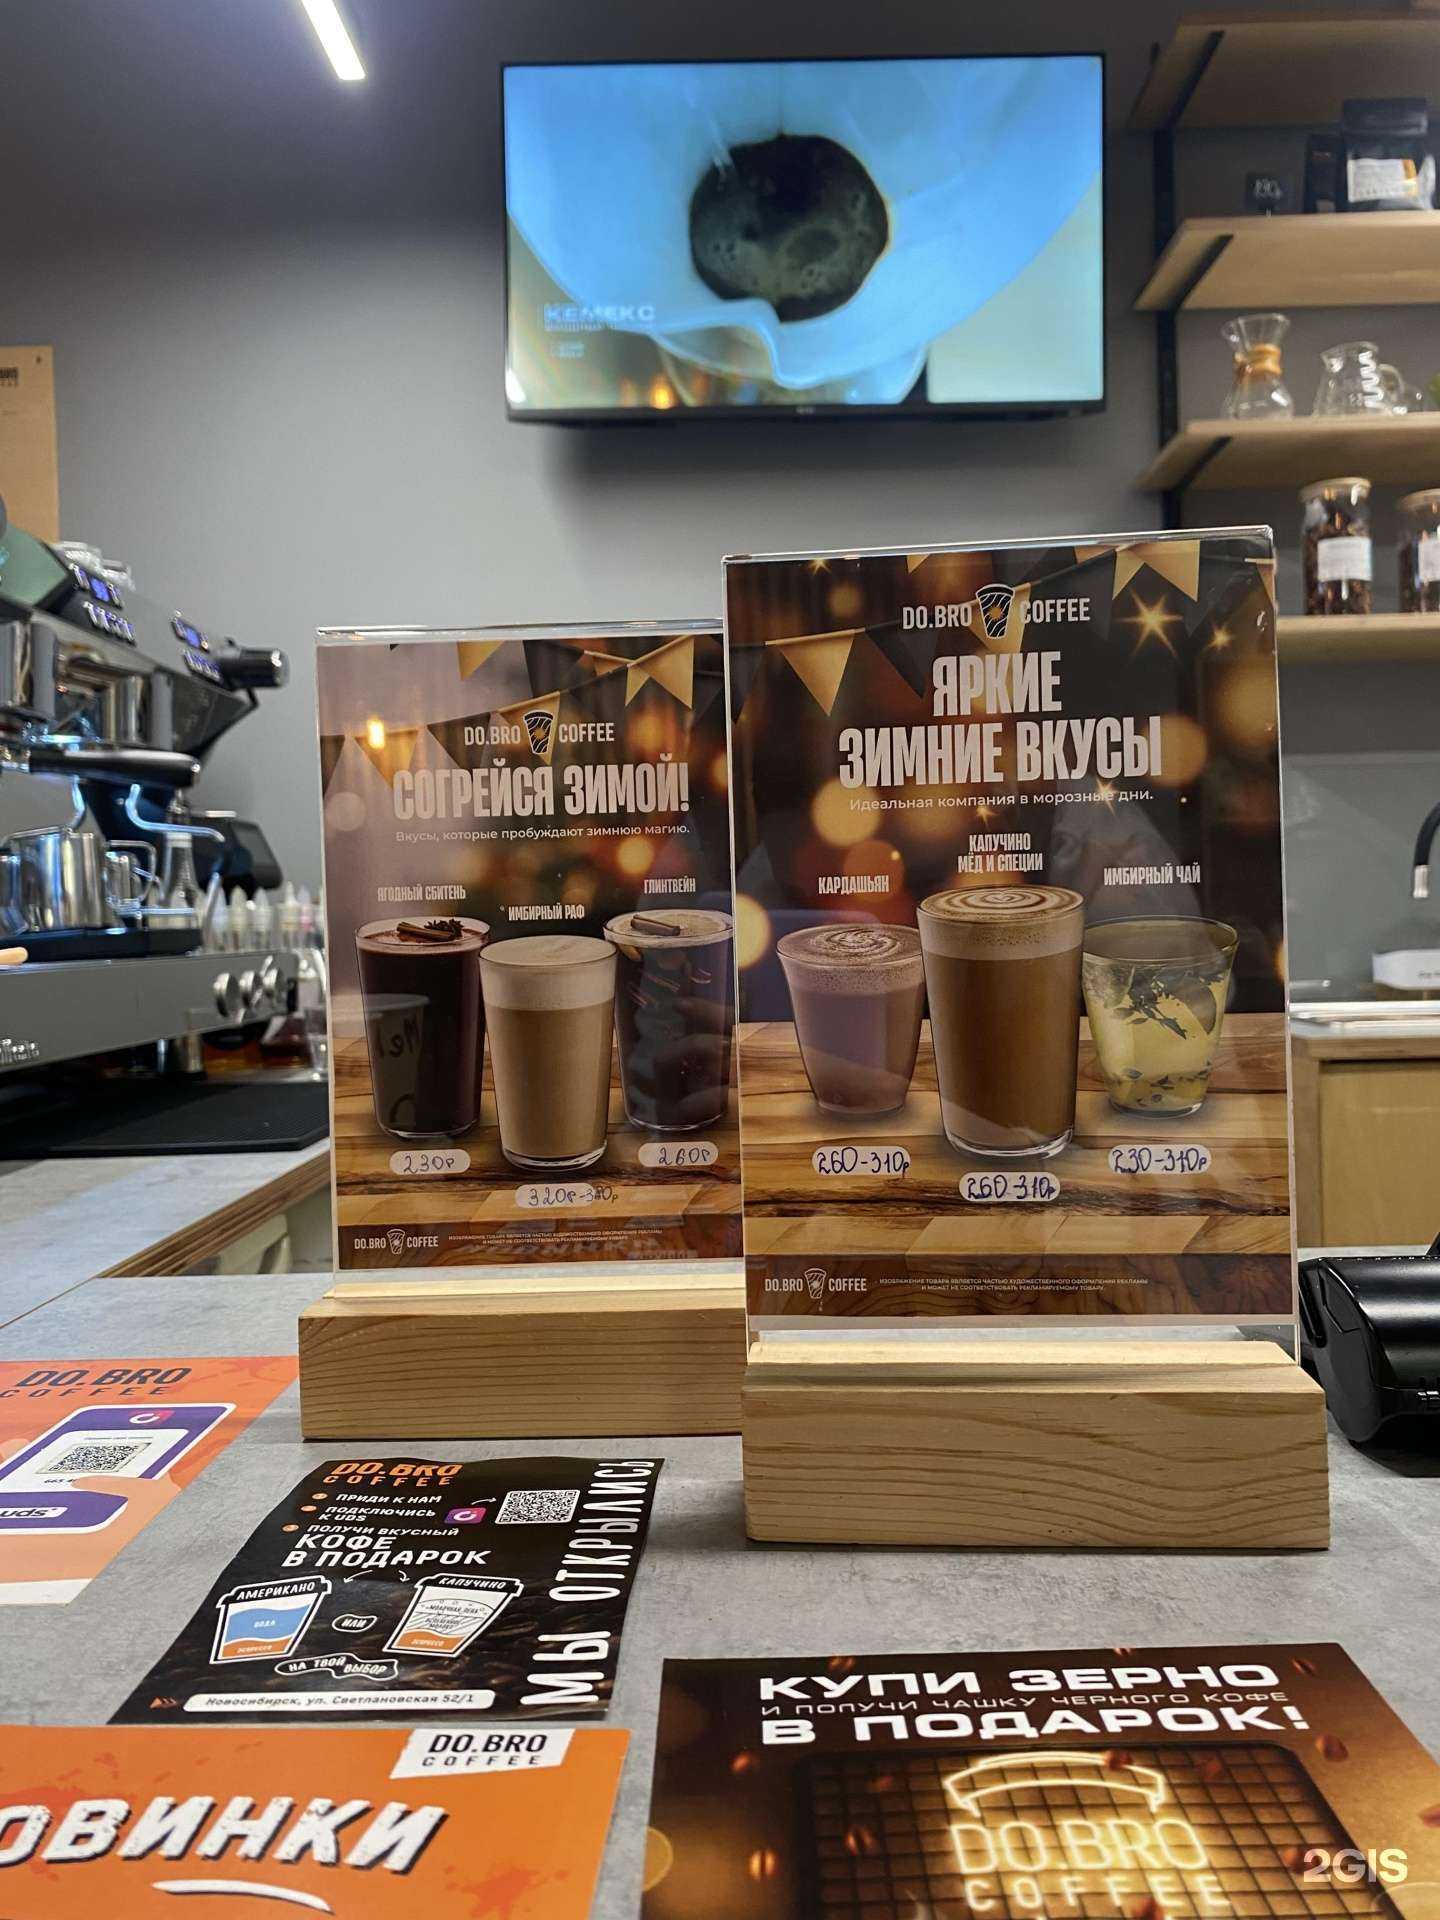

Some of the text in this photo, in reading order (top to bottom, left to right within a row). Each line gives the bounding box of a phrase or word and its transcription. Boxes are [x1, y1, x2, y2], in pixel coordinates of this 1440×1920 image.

[902, 598, 1091, 630] DO.BRO COFFEE
[932, 651, 1062, 717] ЯРКИЕ
[464, 723, 615, 746] DO.BRO COFFEE
[839, 716, 1162, 788] ЗИМНИЕ ВКУСЫ
[393, 753, 690, 820] СОГРЕЙСЯ ЗИМОЙ!
[850, 790, 1154, 812] Идеальная компания в морозные дни.
[396, 824, 690, 845] Вкусы, которые пробуждают зимнюю магию.
[969, 833, 1031, 853] КАПУЧИНО
[958, 852, 1043, 873] МЁД И СПЕЦИИ
[818, 874, 889, 895] КАРДАШЬЯН
[1103, 863, 1201, 886] ИМБИРНЫЙ ЧАЙ
[377, 884, 466, 902] ЯГОДНЫЙ СБИТЕНЬ
[644, 876, 696, 894] ГЛИНТВЕЙН
[508, 903, 585, 921] ИМБИРНЫЙ РАФ
[354, 1235, 439, 1250] DO.BRO COFFEE
[765, 1278, 868, 1292] DO.BRO COFFEE
[15, 1367, 193, 1388] DO.BRO
[0, 1386, 173, 1398] COFFEE
[322, 1475, 454, 1487] COFFEE
[336, 1494, 391, 1503] ПРИДИ
[407, 1495, 442, 1504] НАМ
[325, 1506, 436, 1518] ПОДКЛЮЧИСЬ
[333, 1514, 367, 1522] UDS
[307, 1524, 460, 1537] ПОЛУЧИ ВКУСНЫЙ
[296, 1534, 397, 1551] КОФЕ
[281, 1550, 492, 1568] В ПОДАРОК
[236, 1581, 316, 1601] АМЕРИКАНО
[438, 1577, 508, 1590] КАПУЧИНО
[520, 1461, 655, 1705] МЫ ОТКРЫЛИСЬ
[341, 1618, 367, 1628] ИЛИ
[288, 1656, 347, 1672] НА ТВОЙ
[343, 1662, 387, 1676] ВЫБОР
[760, 1664, 1279, 1700] КУПИ ЗЕРНО
[205, 1694, 475, 1707] Новосибирск, ул. Светлановская 52/1
[762, 1691, 1289, 1717] И ПОЛУЧИ ЧАШКУ ЧЕРНОГО КОФЕ
[762, 1705, 1310, 1745] В ПОДАРОК!
[427, 1732, 547, 1755] DO.BRO
[421, 1754, 543, 1768] COFFEE
[950, 1818, 1210, 1875] DO.BRO
[964, 1873, 1232, 1912] COFFEE
